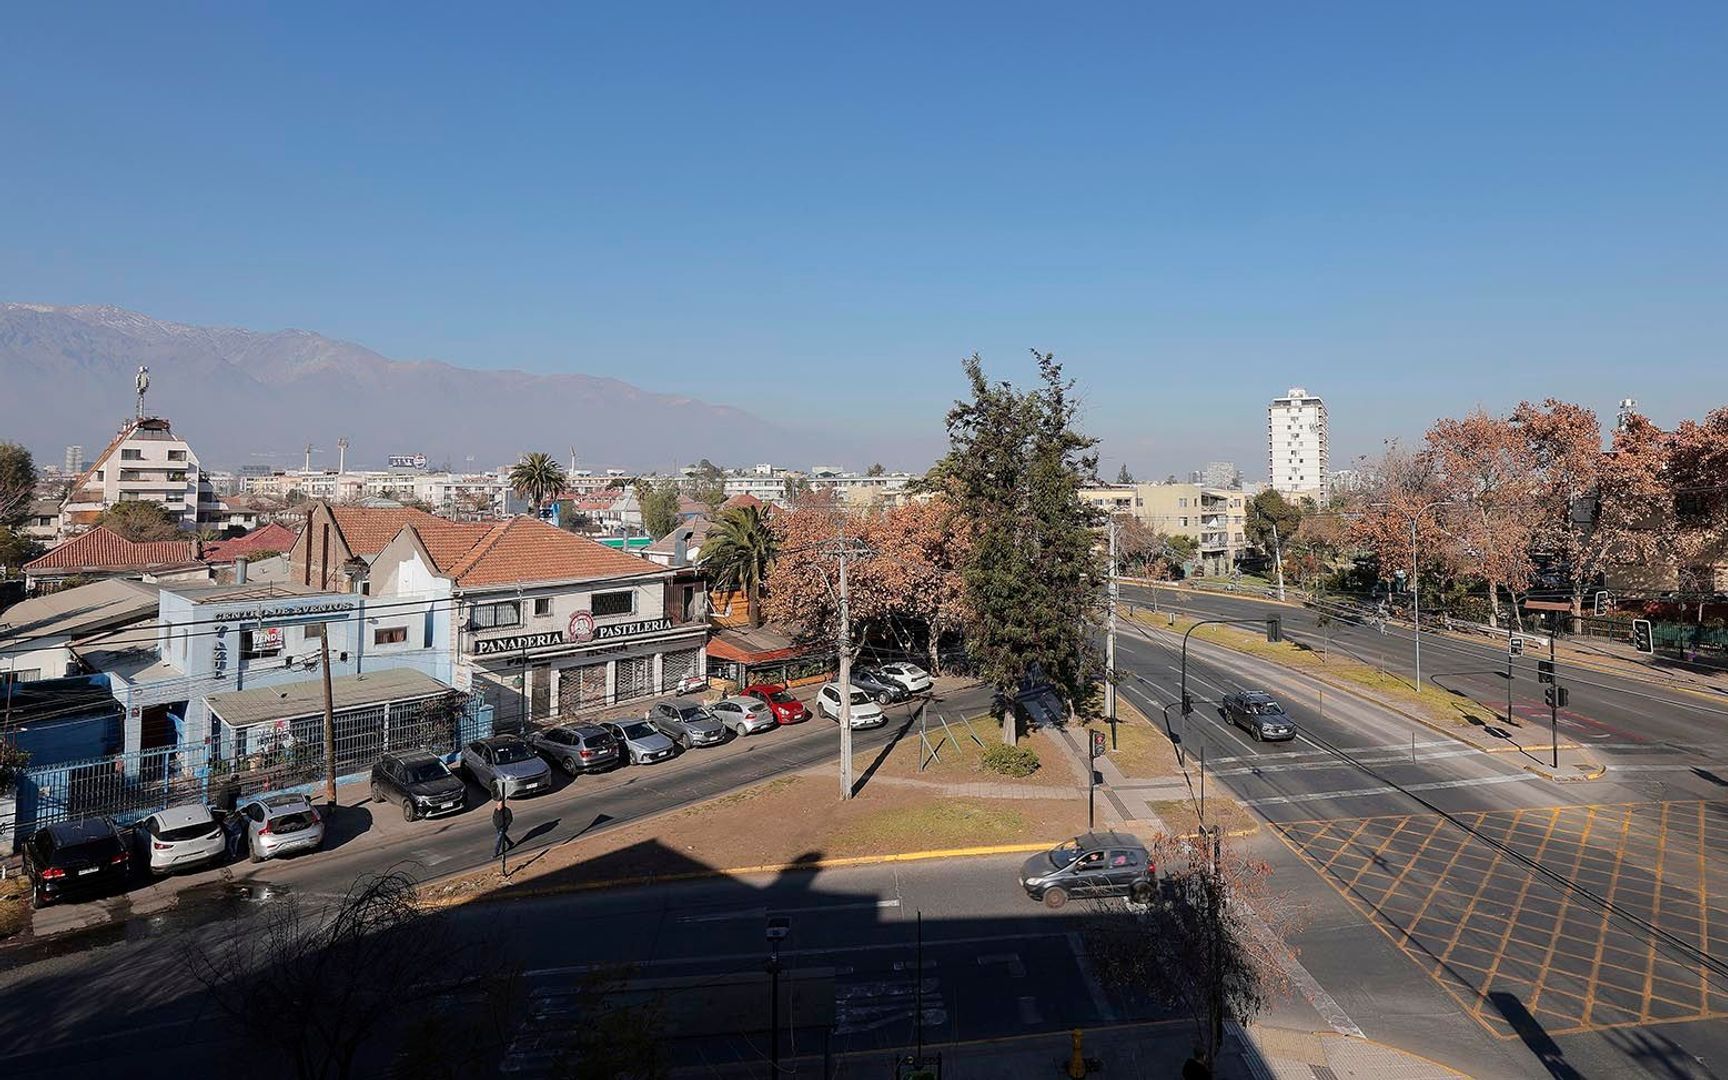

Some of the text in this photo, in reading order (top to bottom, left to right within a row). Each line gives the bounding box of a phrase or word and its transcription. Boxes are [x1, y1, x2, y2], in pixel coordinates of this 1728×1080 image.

[274, 606, 291, 617] DE
[293, 602, 354, 616] EVENTOS
[599, 619, 672, 638] PASTELERIA
[478, 633, 561, 653] PANADERIA
